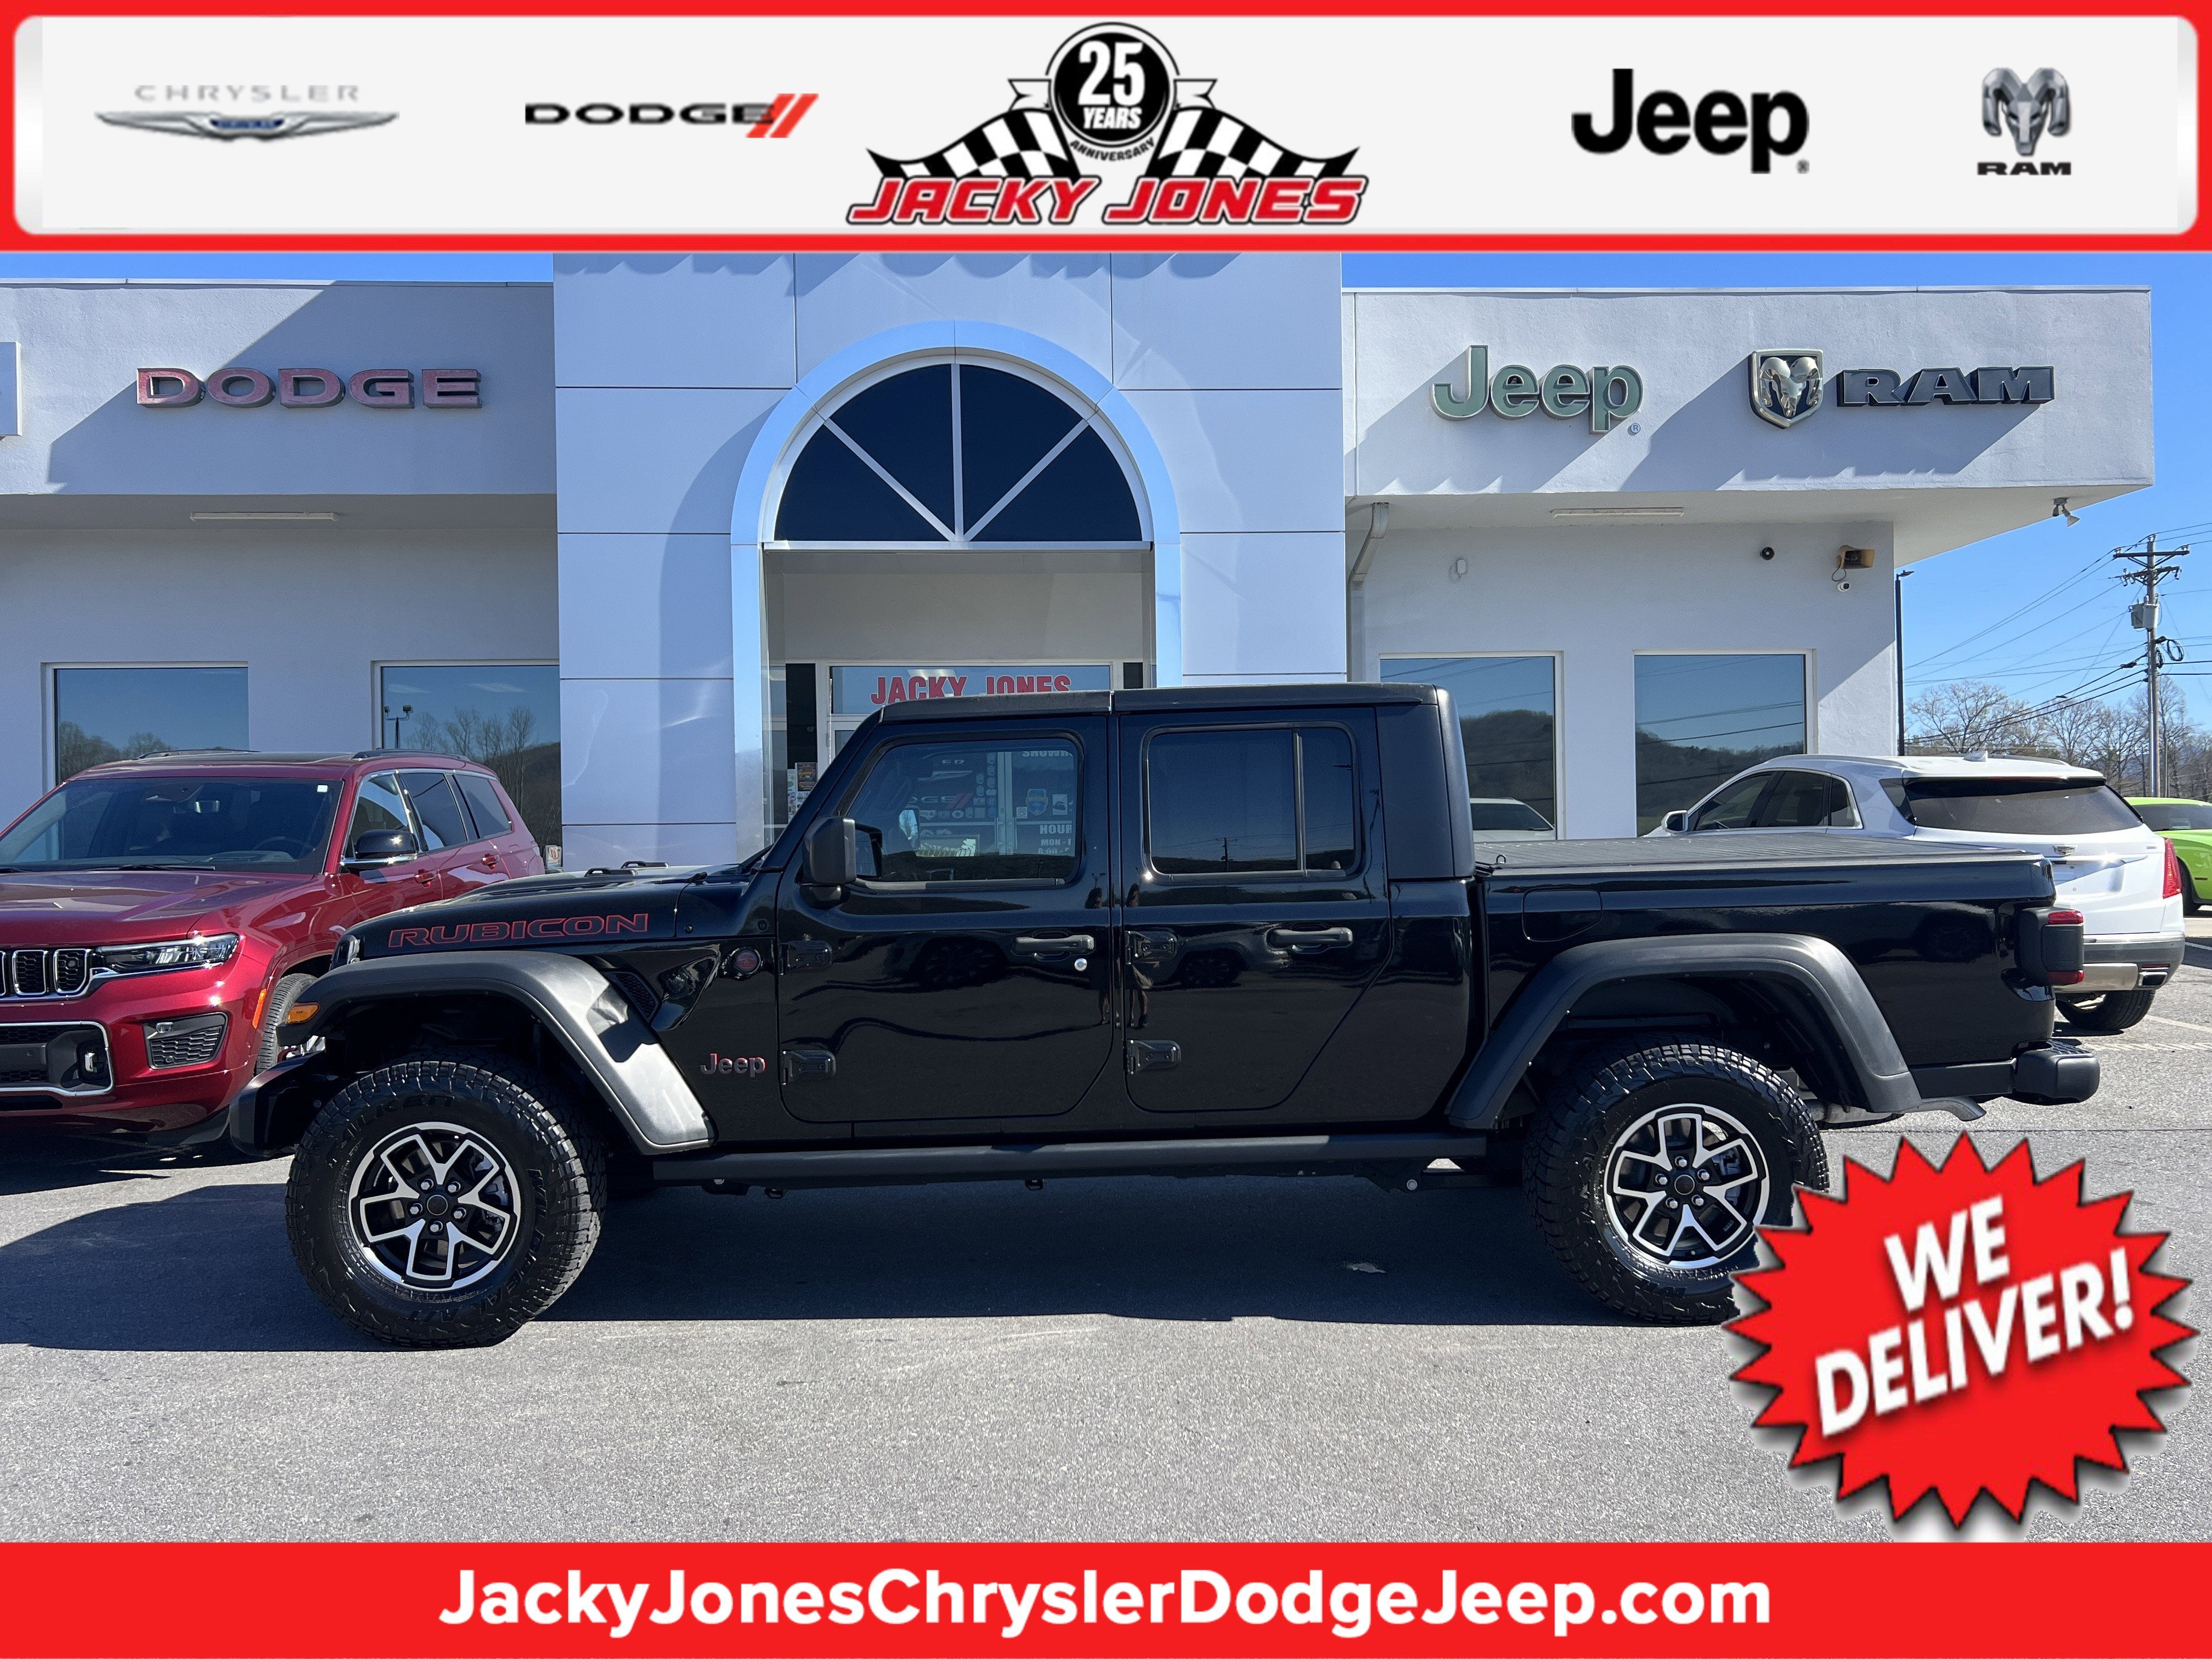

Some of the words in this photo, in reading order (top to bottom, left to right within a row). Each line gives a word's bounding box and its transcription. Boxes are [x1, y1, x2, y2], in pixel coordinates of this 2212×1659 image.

[137, 368, 482, 409] DODGE
[1431, 345, 1644, 433] Jeep
[1837, 366, 2055, 407] RAM
[871, 676, 968, 705] JACKY
[986, 675, 1071, 696] JONES
[388, 912, 648, 948] RUBICON
[700, 1053, 765, 1079] Jeep
